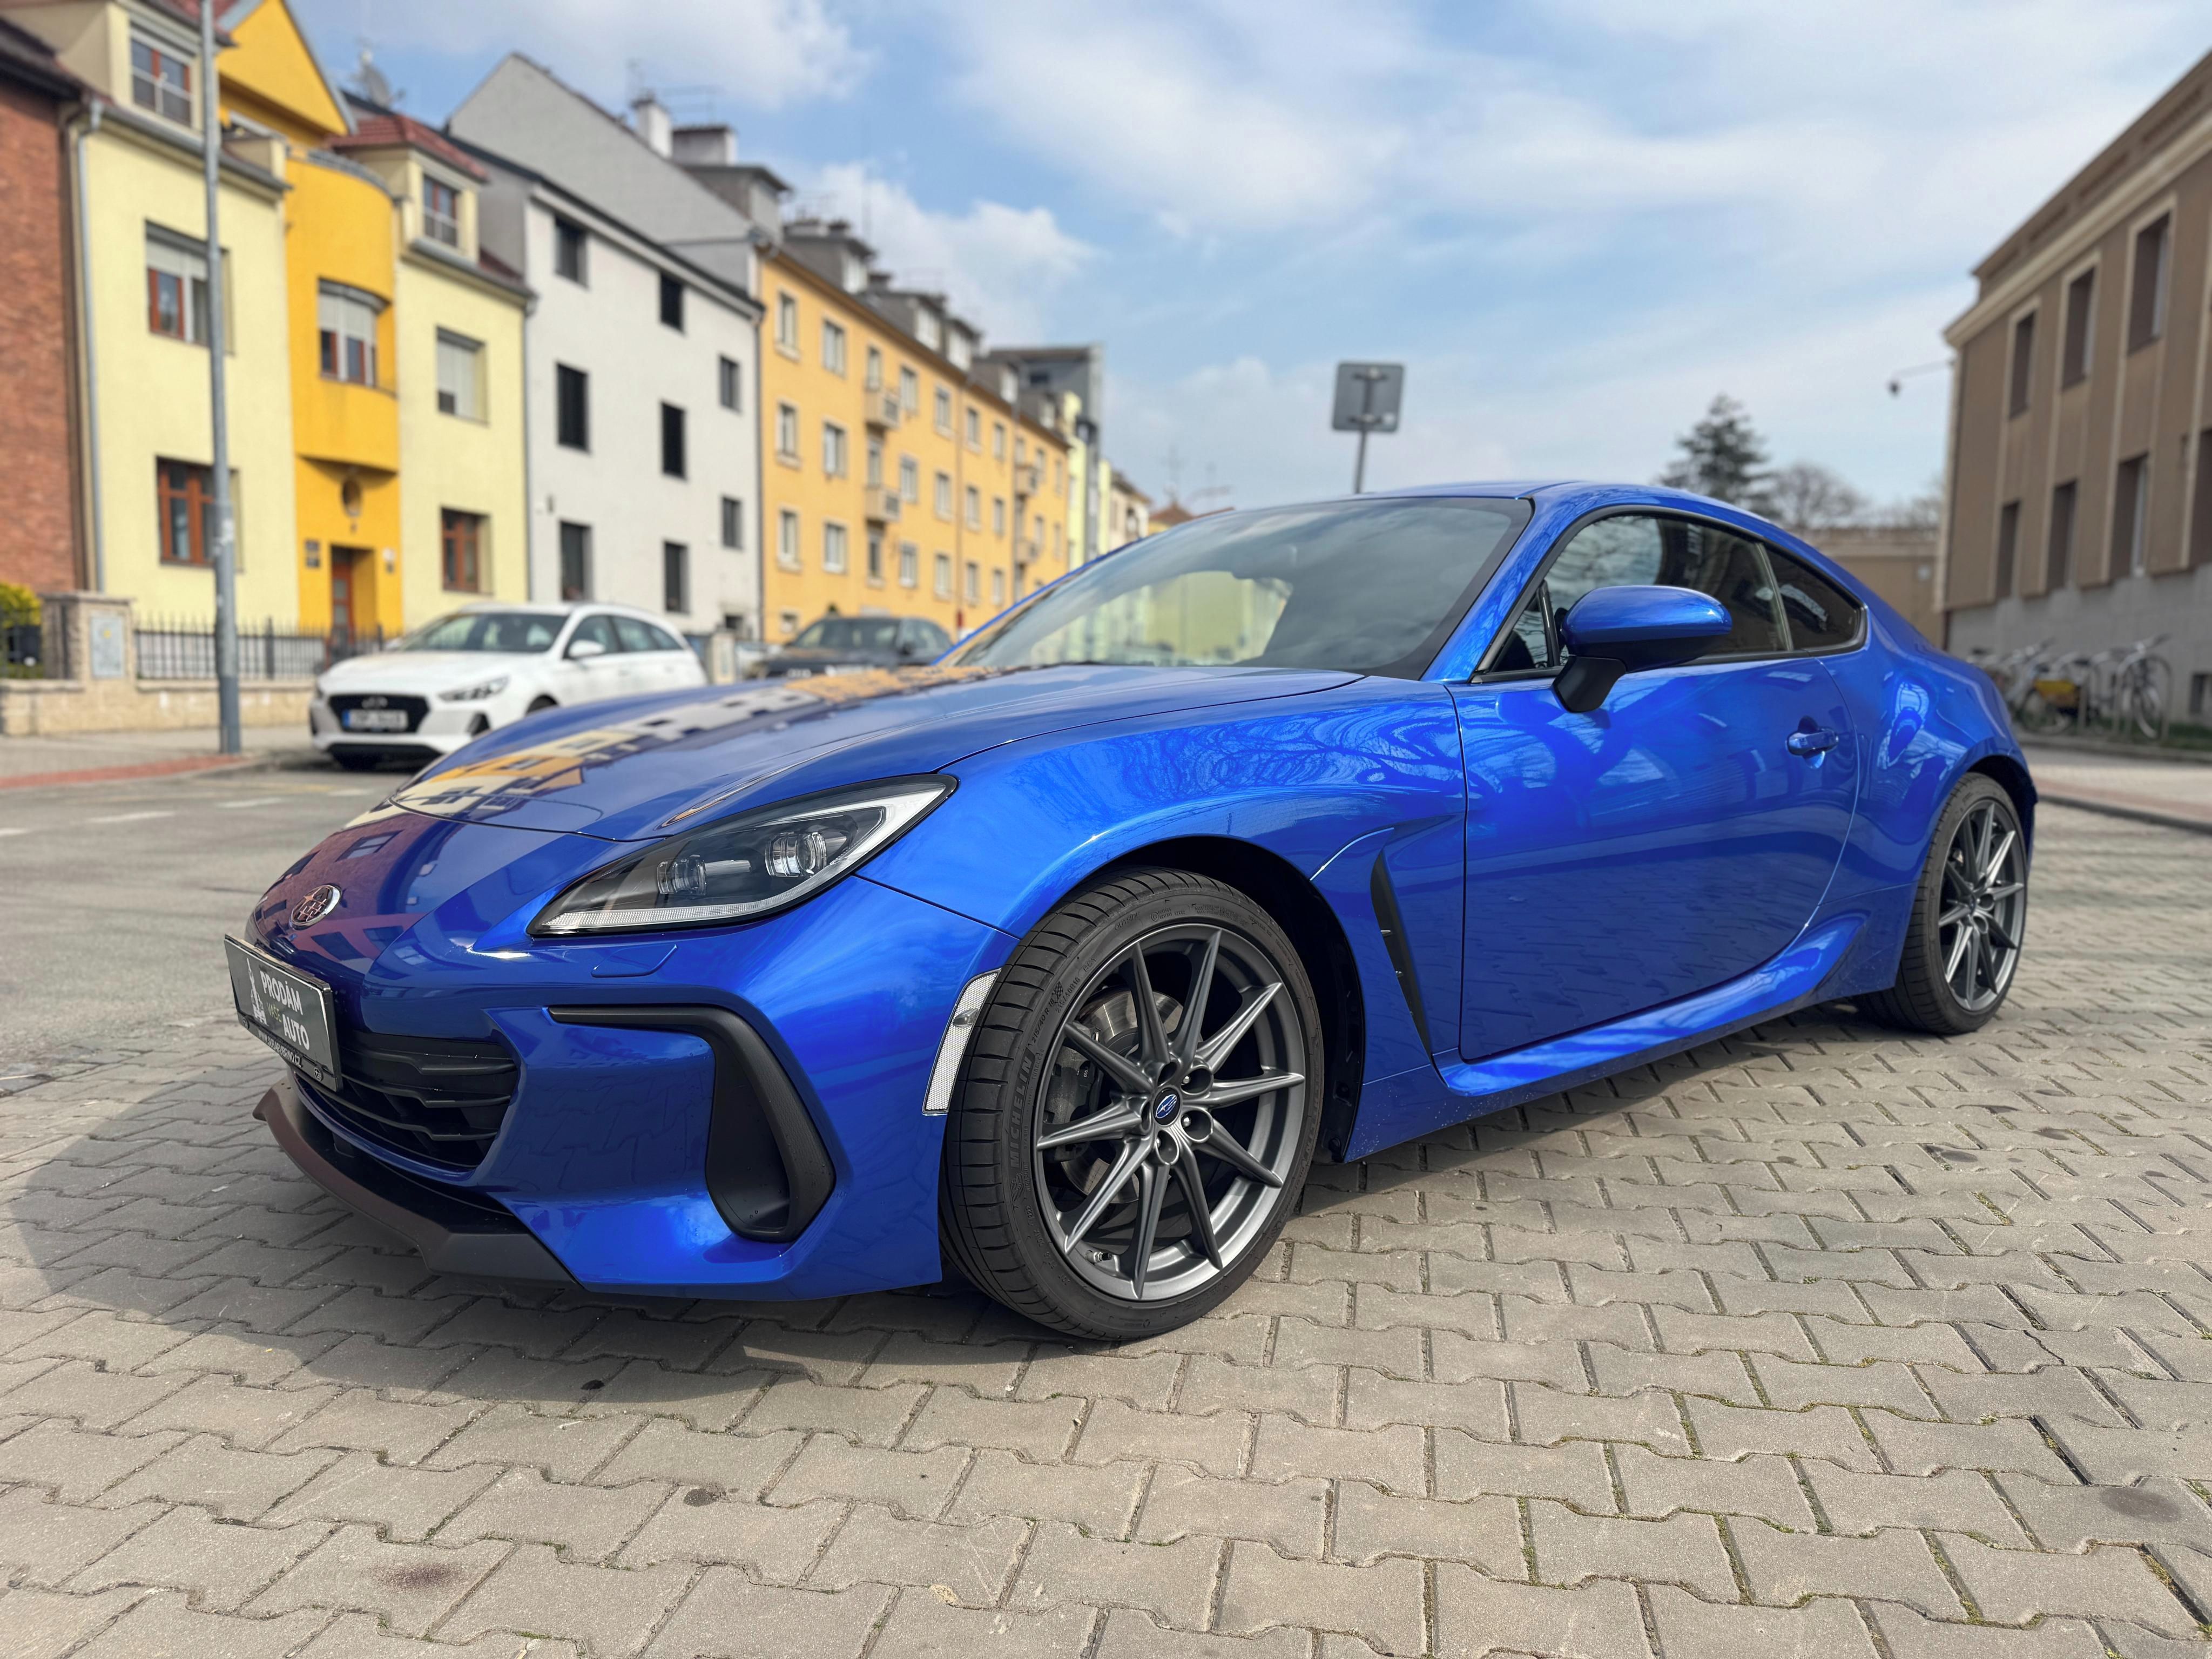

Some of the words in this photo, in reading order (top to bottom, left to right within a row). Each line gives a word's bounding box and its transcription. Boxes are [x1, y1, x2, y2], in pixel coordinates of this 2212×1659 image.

[260, 970, 303, 1015] PRODÁM
[282, 1014, 309, 1050] AUTO
[1031, 1015, 1046, 1043] 215/40
[1044, 1007, 1050, 1015] R
[1010, 1056, 1032, 1168] MICHELIN
